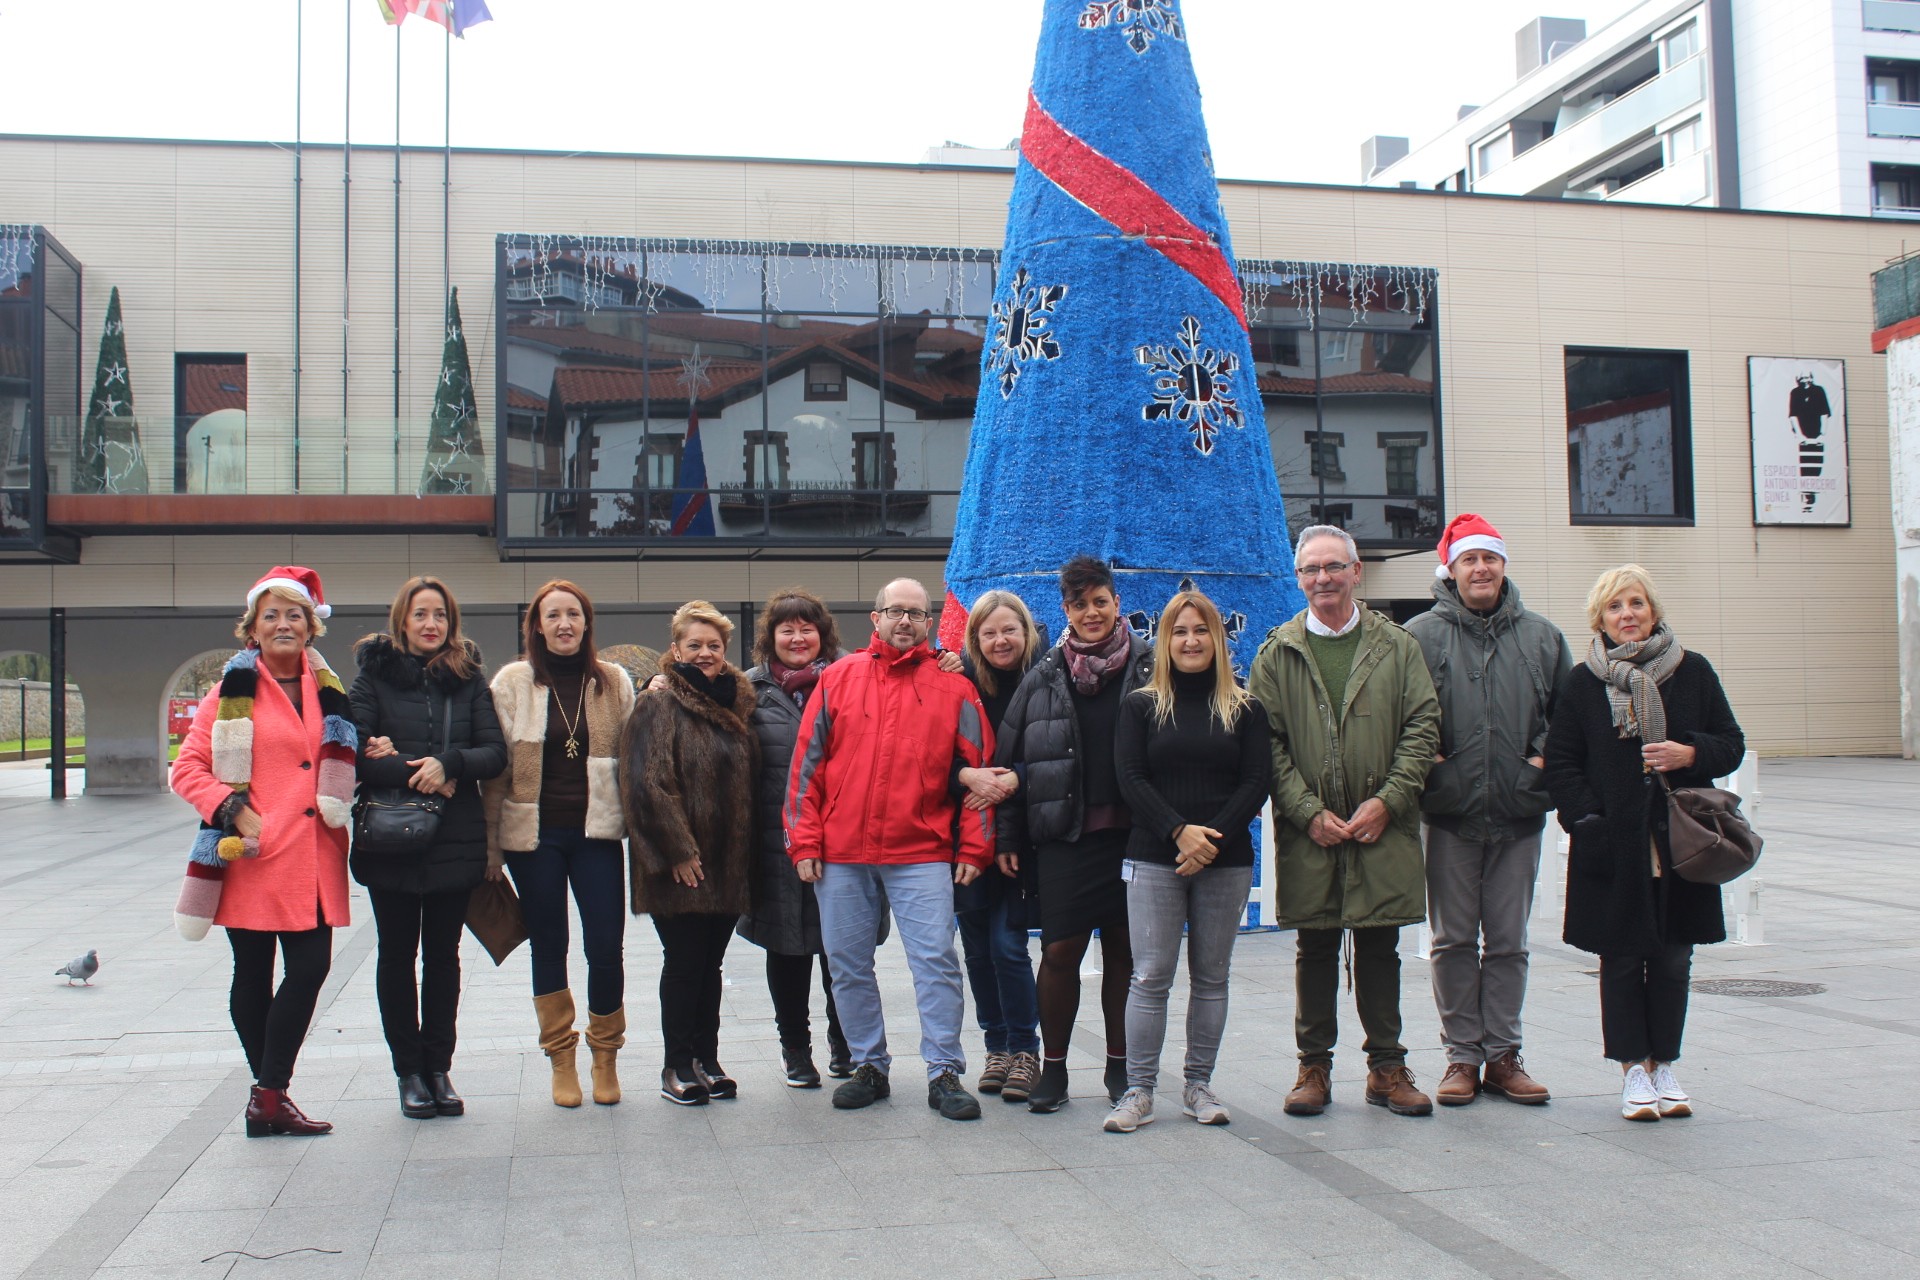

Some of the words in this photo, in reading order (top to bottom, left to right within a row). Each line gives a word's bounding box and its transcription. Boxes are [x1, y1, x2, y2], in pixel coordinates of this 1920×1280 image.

[1763, 465, 1797, 477] ESPACIO
[1764, 478, 1797, 490] ANTONIO
[1800, 479, 1836, 490] MERCERO
[1764, 491, 1790, 502] GUNEA
